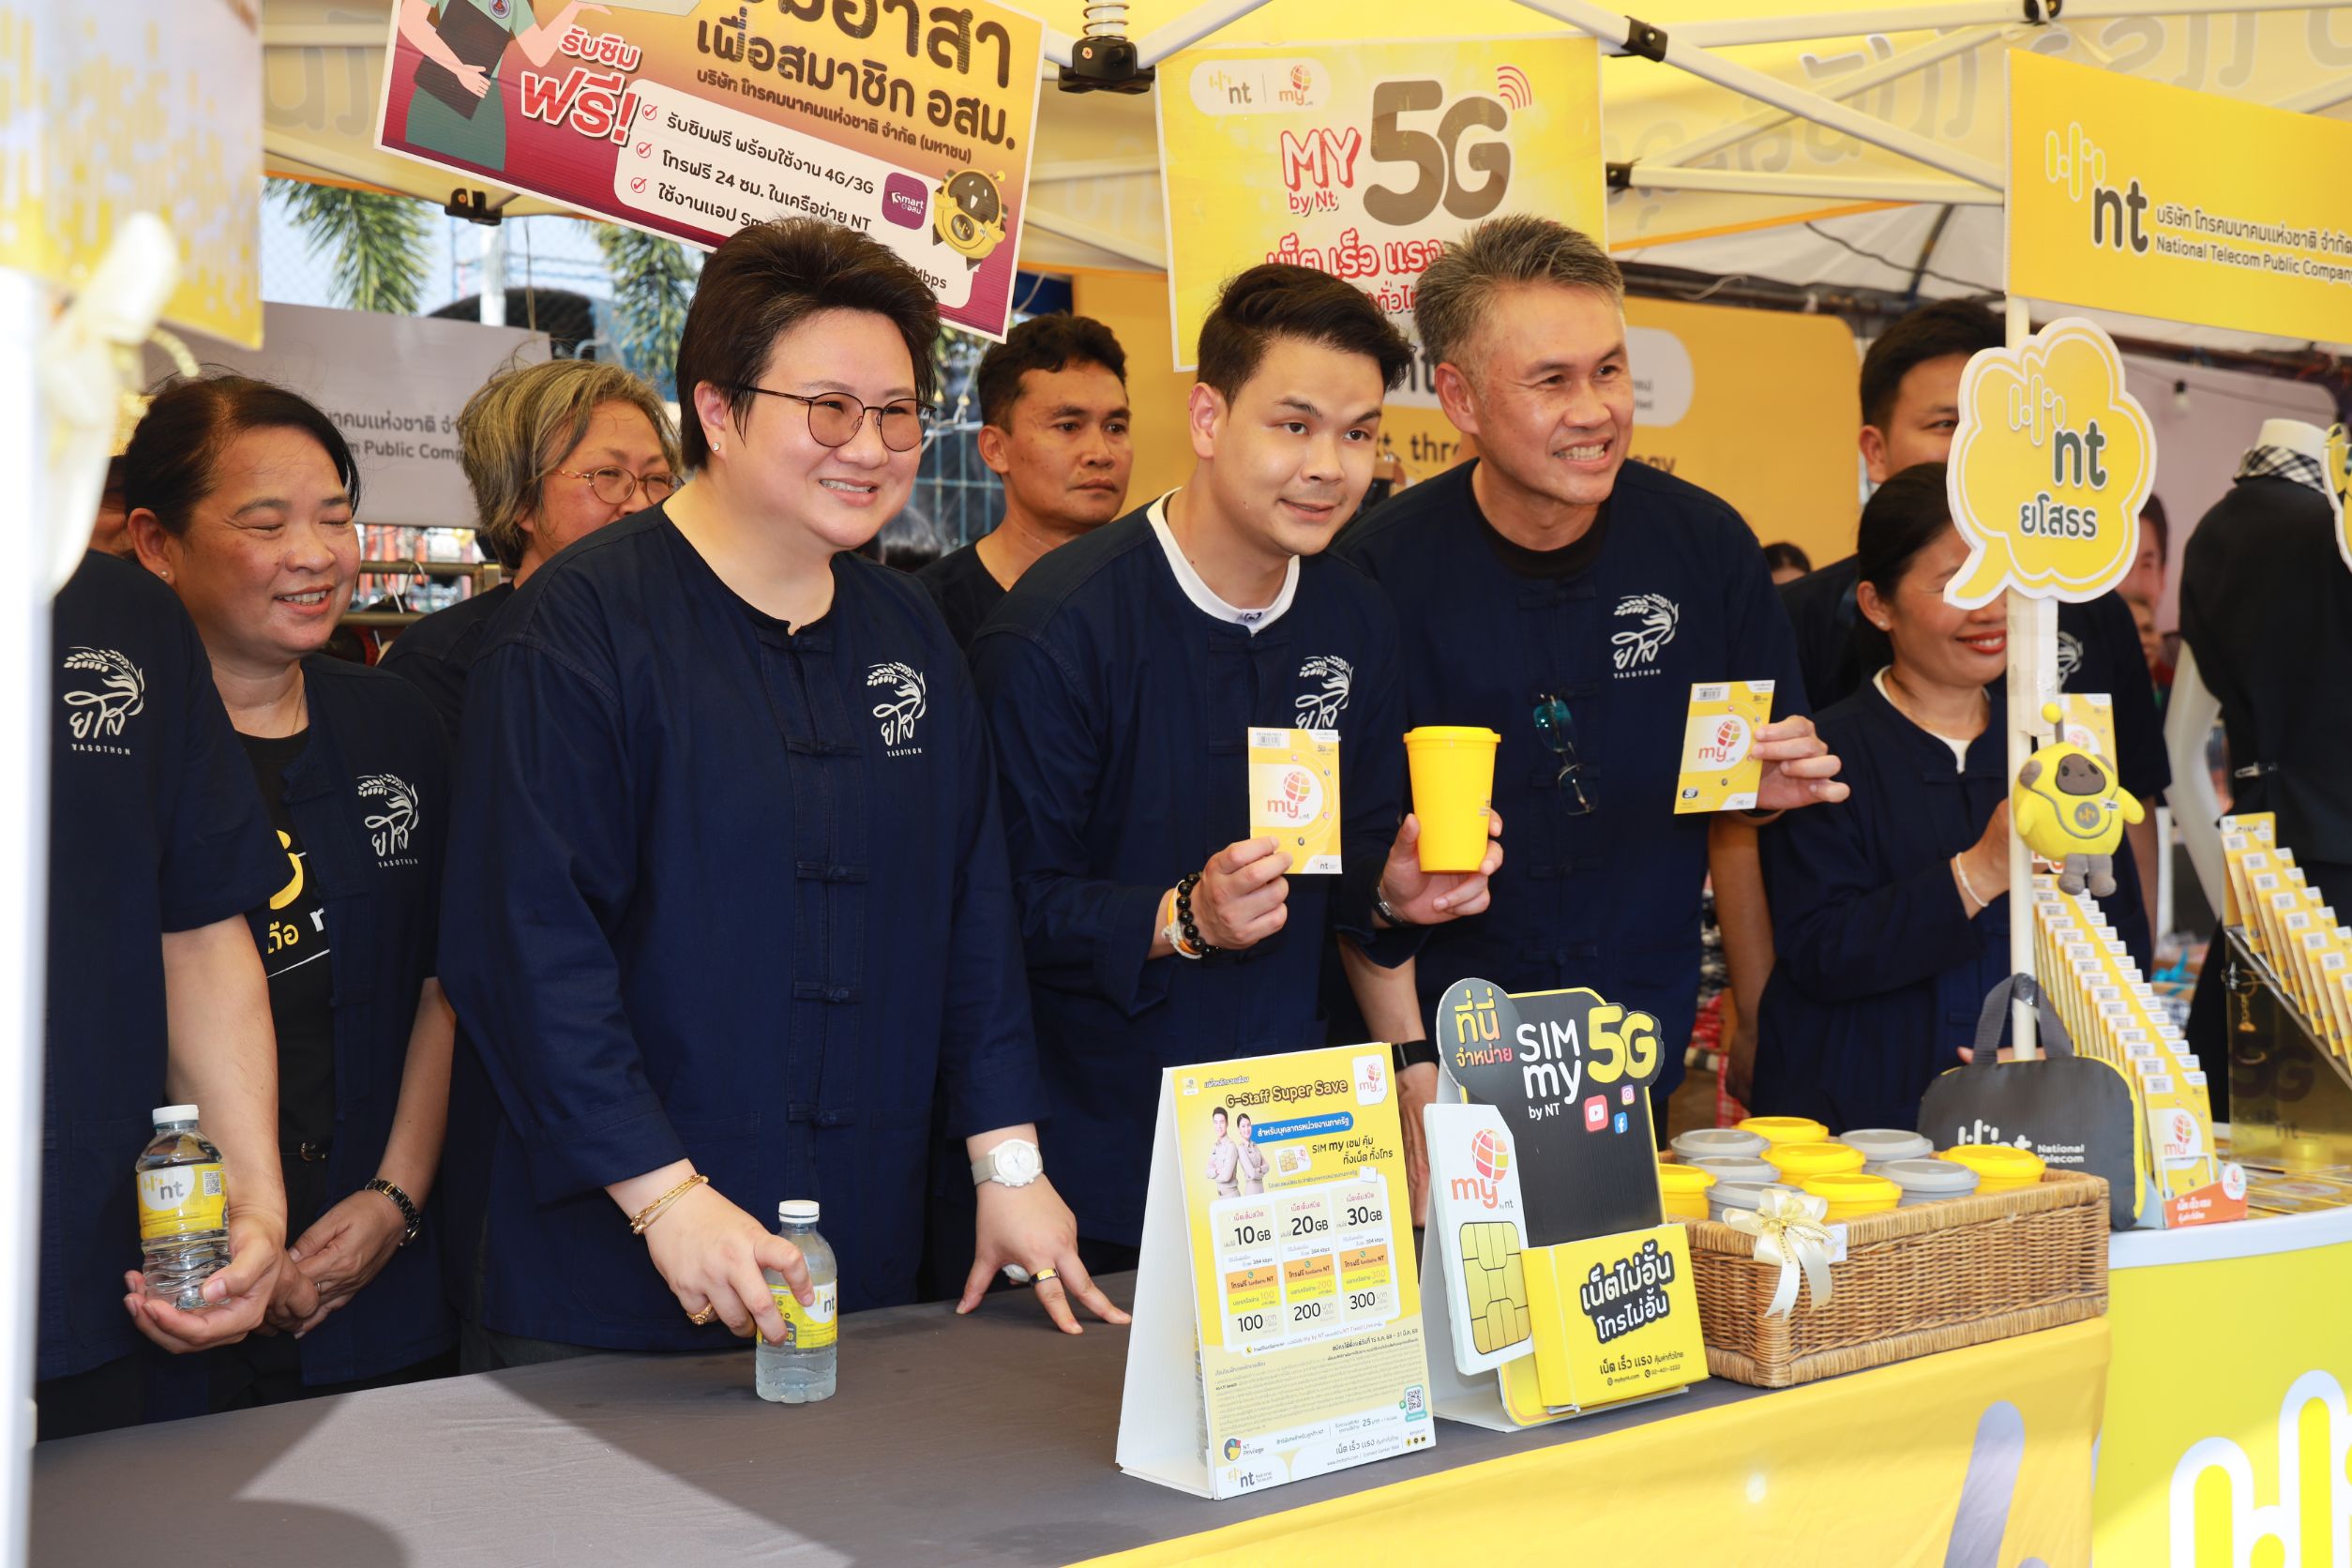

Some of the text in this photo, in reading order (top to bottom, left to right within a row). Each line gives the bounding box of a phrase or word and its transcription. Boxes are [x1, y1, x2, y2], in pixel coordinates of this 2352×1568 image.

[560, 25, 640, 70] รับซิม
[696, 5, 1017, 151] เพื่อสมาชิก อสม.
[1229, 82, 1253, 105] nt
[1279, 89, 1305, 107] my
[521, 68, 639, 144] ฟรี!
[696, 68, 972, 165] บริษัท โทรคมนาคมแห่งชาติ จำกัด (มหาชน)
[667, 111, 875, 196] รับซิมฟรี พร้อมใช้งาน 4G/3G
[1280, 126, 1363, 192] MY
[1363, 79, 1512, 227] 5G
[657, 182, 737, 223] ใช้งานแอป
[662, 149, 873, 233] โทรฟรี 24 ซม. ในเครือข่าย NT
[891, 190, 924, 209] Smart
[1288, 190, 1338, 215] by Nt
[2093, 180, 2148, 253] nt
[2156, 204, 2193, 230] บริษัท
[2194, 208, 2317, 250] โทรคมนาคมแห่งชาติ
[2156, 235, 2352, 285] National Telecom Public Compan
[364, 439, 415, 459] Public
[2055, 421, 2106, 488] nt
[2020, 492, 2097, 538] ยโสธร
[1613, 669, 1662, 680] YASOTHON
[71, 742, 131, 756] YASOTHON
[1697, 745, 1727, 762] my
[1266, 798, 1300, 819] my
[1454, 987, 1501, 1044] ที่นี่
[1515, 1004, 1658, 1084] SIM 5G
[1455, 1043, 1514, 1069] จำหน่าย
[1225, 1078, 1349, 1108] G-Staff Super Save
[1358, 1080, 1378, 1093] my
[1522, 1059, 1582, 1106] my
[1528, 1102, 1560, 1122] by NT
[1311, 1143, 1327, 1154] SIM
[1328, 1140, 1344, 1153] my
[1362, 1134, 1375, 1150] คุ้ม
[2037, 1143, 2086, 1154] National
[2038, 1153, 2086, 1164] Telecom
[159, 1181, 185, 1200] nt
[1451, 1177, 1499, 1210] my
[1290, 1215, 1329, 1236] 20 GB
[1347, 1206, 1369, 1226] 30
[1369, 1210, 1383, 1222] GB
[1234, 1226, 1272, 1246] 10 GB
[1581, 1242, 1672, 1311] เน็ตไม่อั้น
[1293, 1303, 1321, 1321] 200
[1349, 1291, 1376, 1310] 300
[1237, 1314, 1263, 1333] 100
[1596, 1287, 1667, 1339] โทรไม่อั้น
[1599, 1357, 1617, 1376] เน็ต
[1617, 1353, 1633, 1372] เร็ว
[1634, 1354, 1653, 1367] แรง
[1362, 1417, 1371, 1427] 25
[1335, 1439, 1376, 1455] เน็ต เร็ว แรง
[1240, 1471, 1256, 1488] nt
